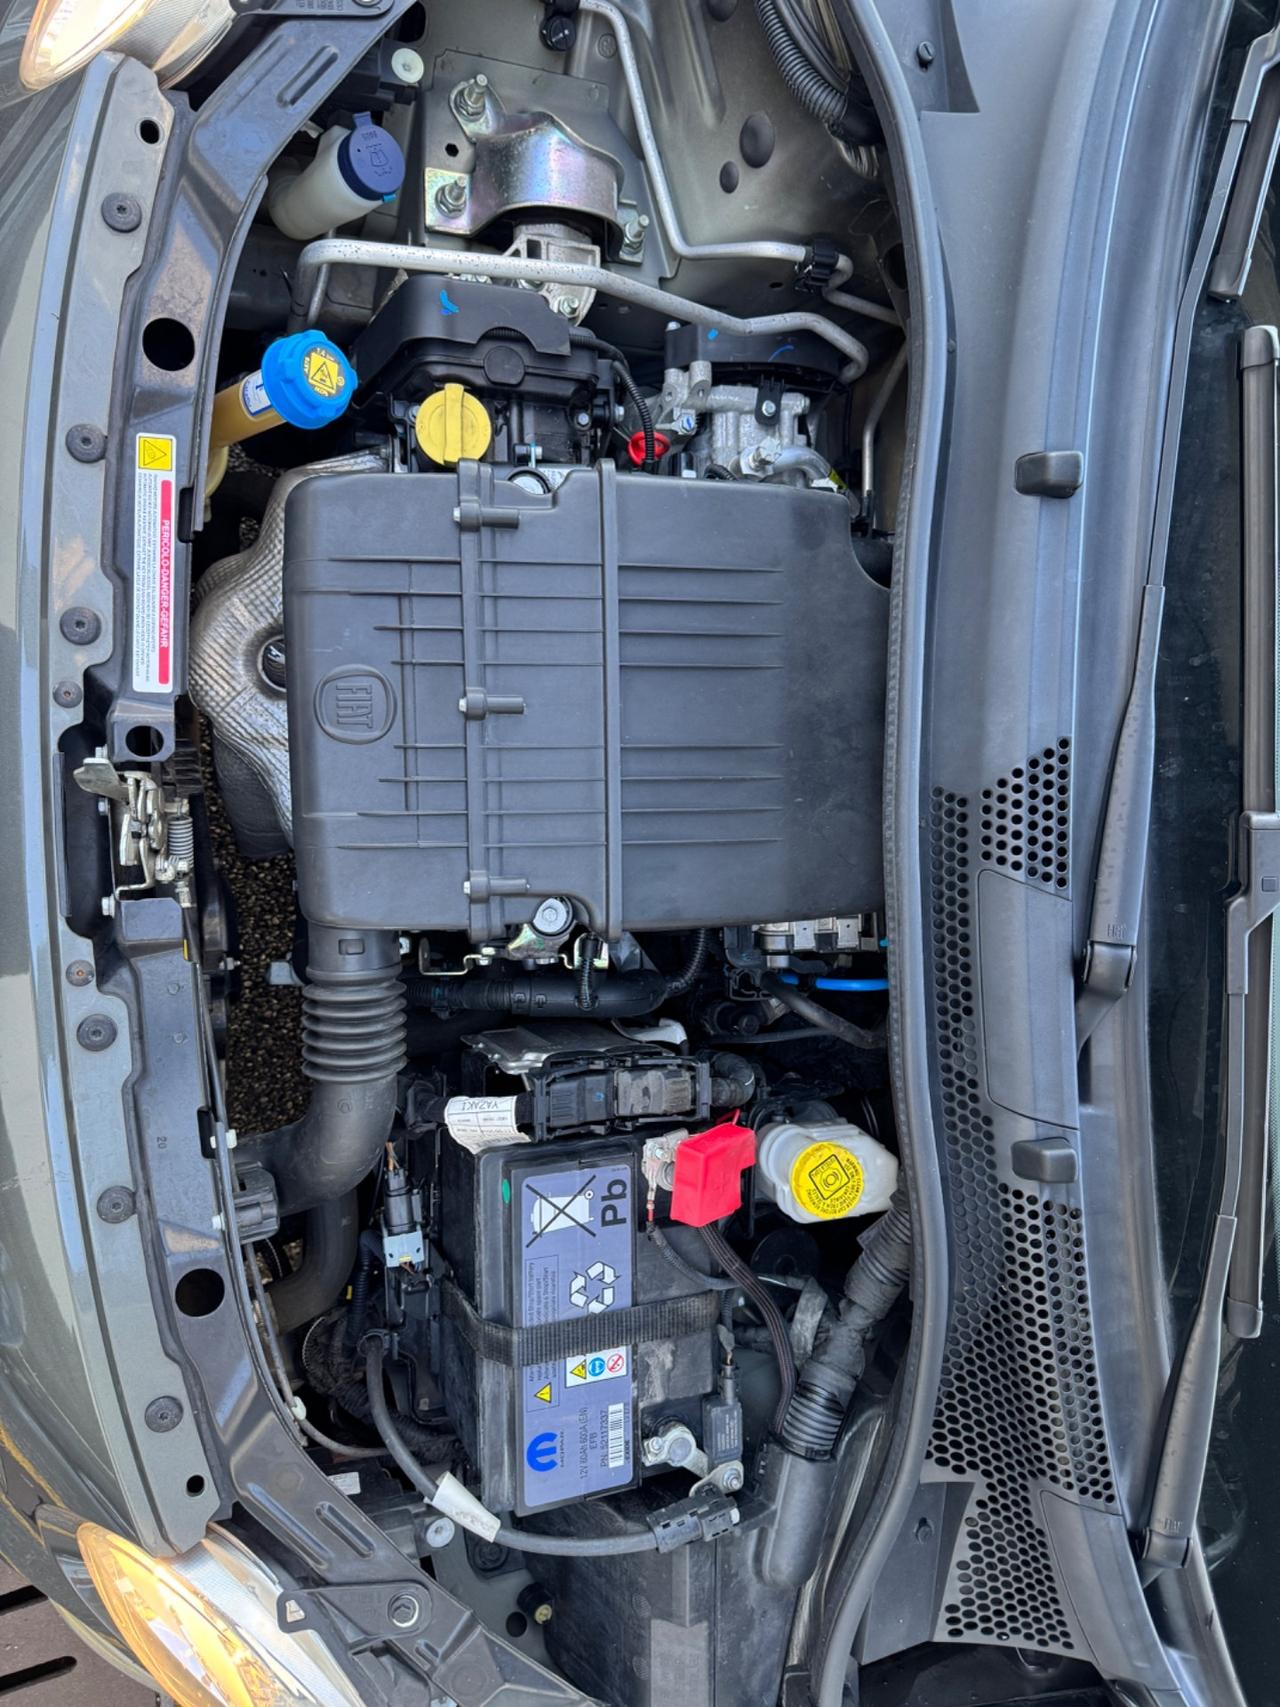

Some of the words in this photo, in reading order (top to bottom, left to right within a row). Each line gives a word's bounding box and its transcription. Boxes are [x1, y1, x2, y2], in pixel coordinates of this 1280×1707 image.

[160, 519, 170, 648] PERICOLO-DANGER-GEFAHR
[336, 682, 373, 729] FIAT
[601, 1178, 627, 1228] Pb
[589, 1432, 597, 1449] EFB
[600, 1410, 608, 1450] 52117337
[580, 1465, 588, 1479] 12V
